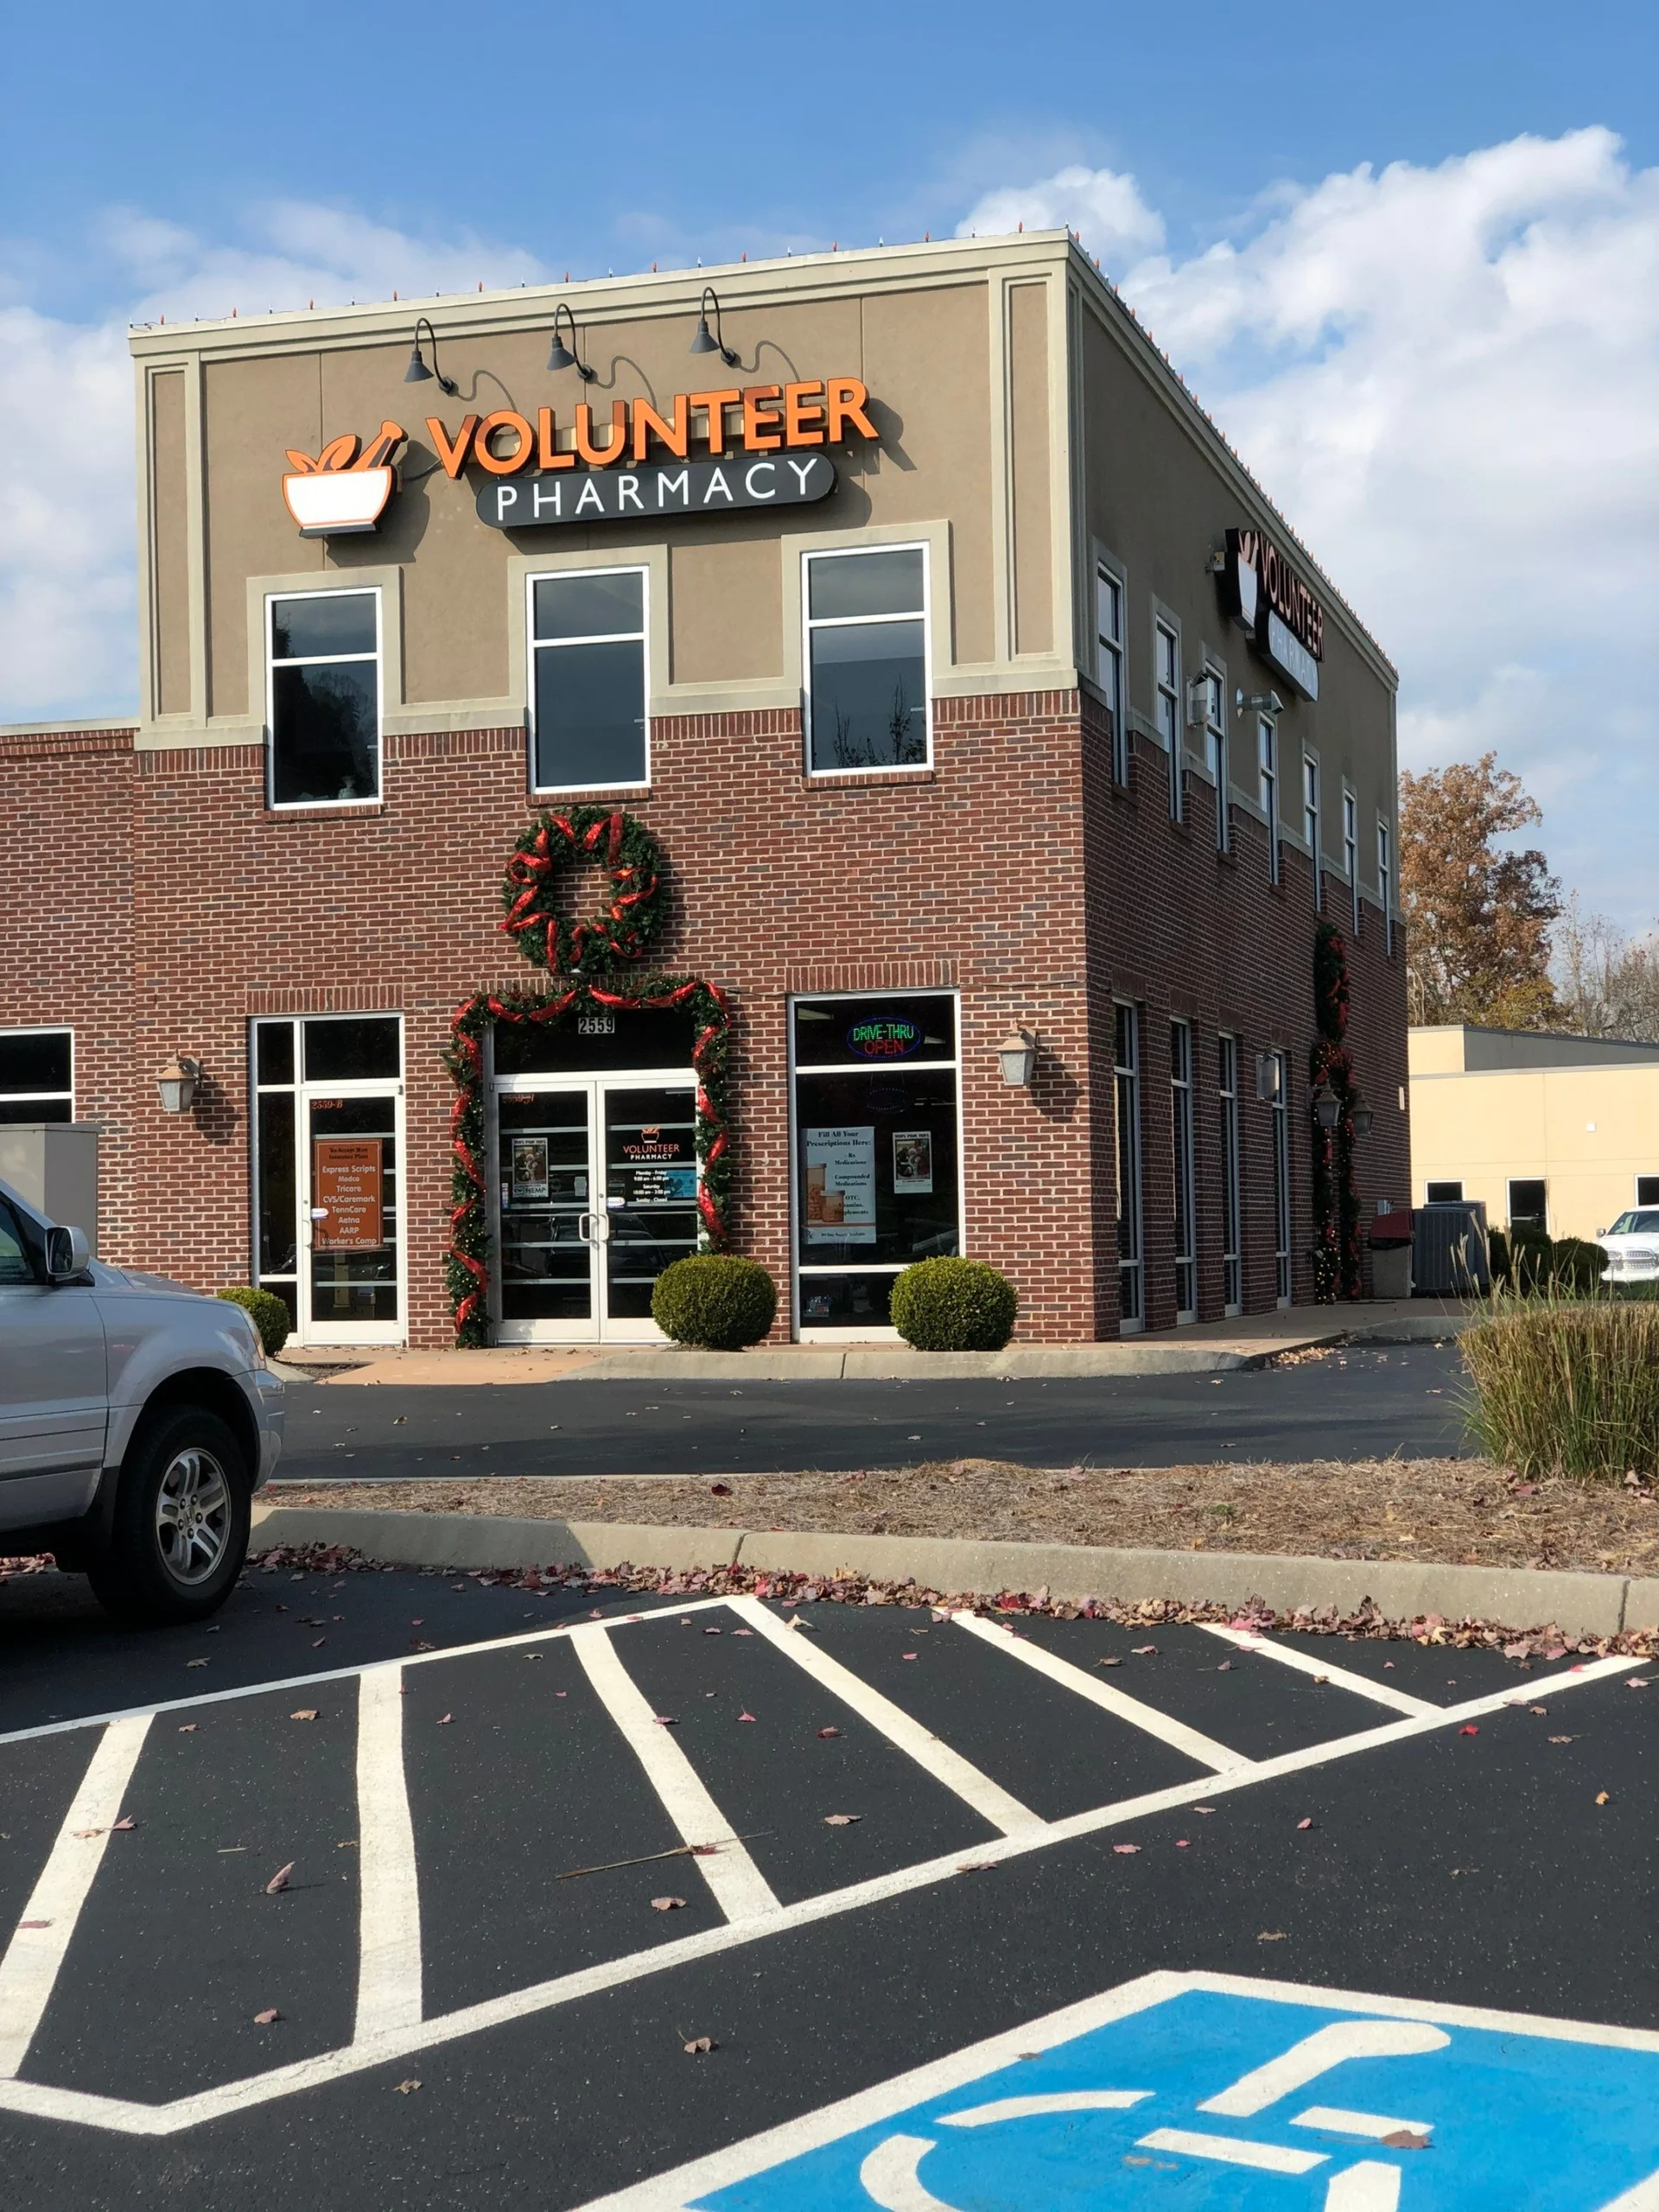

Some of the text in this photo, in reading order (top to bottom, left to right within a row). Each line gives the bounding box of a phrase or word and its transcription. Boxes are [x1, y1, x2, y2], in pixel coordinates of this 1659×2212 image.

[425, 377, 880, 480] VOLUNTEER
[496, 458, 819, 521] PHARMACY
[1257, 530, 1325, 663] VOLUNTEER
[579, 1017, 614, 1033] 2559
[853, 1023, 914, 1042] DRIVE-THRU
[864, 1039, 905, 1055] OPEN
[311, 1099, 343, 1110] 2559-B
[623, 1143, 680, 1154] VOLUNTEER
[322, 1165, 376, 1174] Express Scripts
[355, 1237, 377, 1246] Comp
